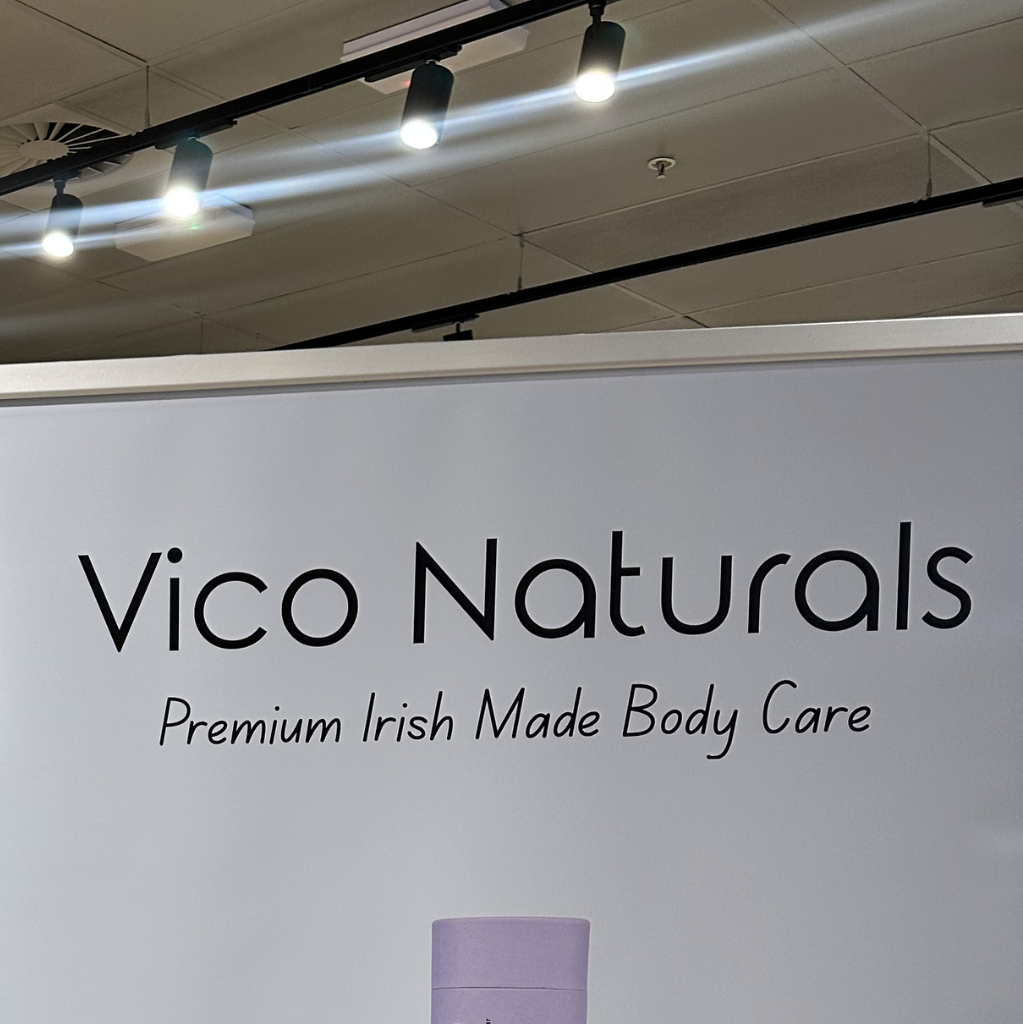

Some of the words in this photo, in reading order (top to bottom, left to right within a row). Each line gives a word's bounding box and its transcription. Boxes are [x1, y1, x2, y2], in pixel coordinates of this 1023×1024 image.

[77, 546, 358, 652] Vico
[412, 522, 972, 643] Naturals
[159, 698, 340, 745] Premium
[362, 690, 454, 741] Irish
[475, 686, 600, 739] Made
[622, 683, 739, 759] Body
[762, 680, 871, 734] Care
